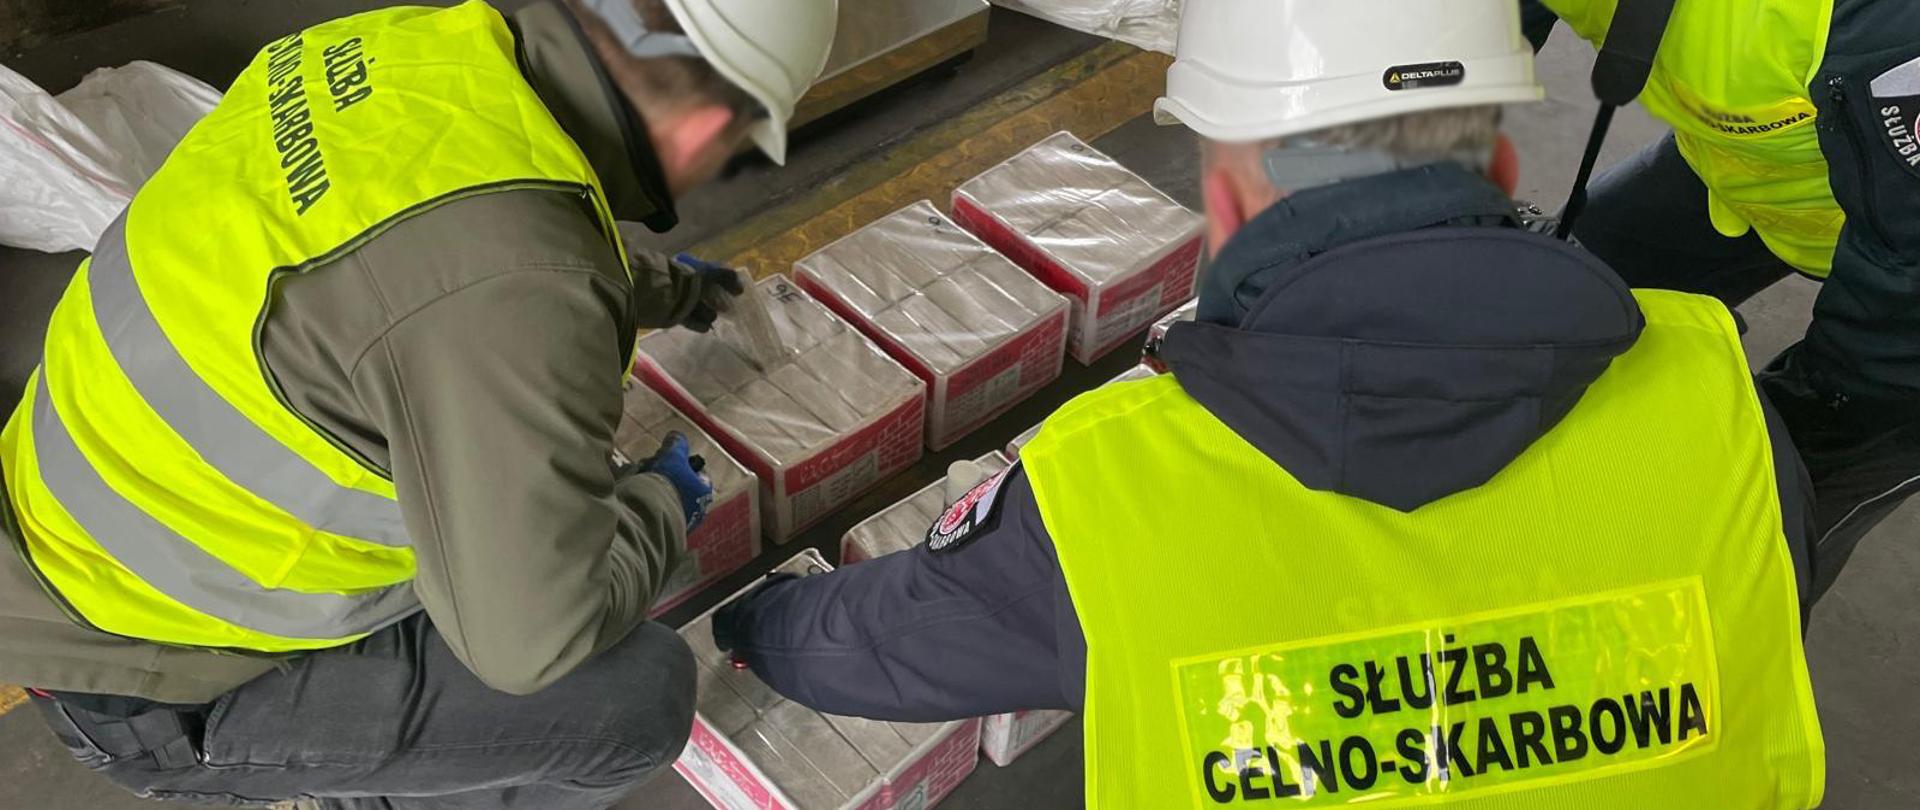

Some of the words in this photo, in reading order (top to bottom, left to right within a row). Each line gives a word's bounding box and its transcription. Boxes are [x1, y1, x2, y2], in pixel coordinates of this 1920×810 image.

[322, 37, 375, 113] SŁUŻBA
[1881, 105, 1920, 167] SŁUŻBA
[1329, 634, 1555, 719] SŁUŻBA
[1202, 683, 1708, 804] CELNO-SKARBOWA
